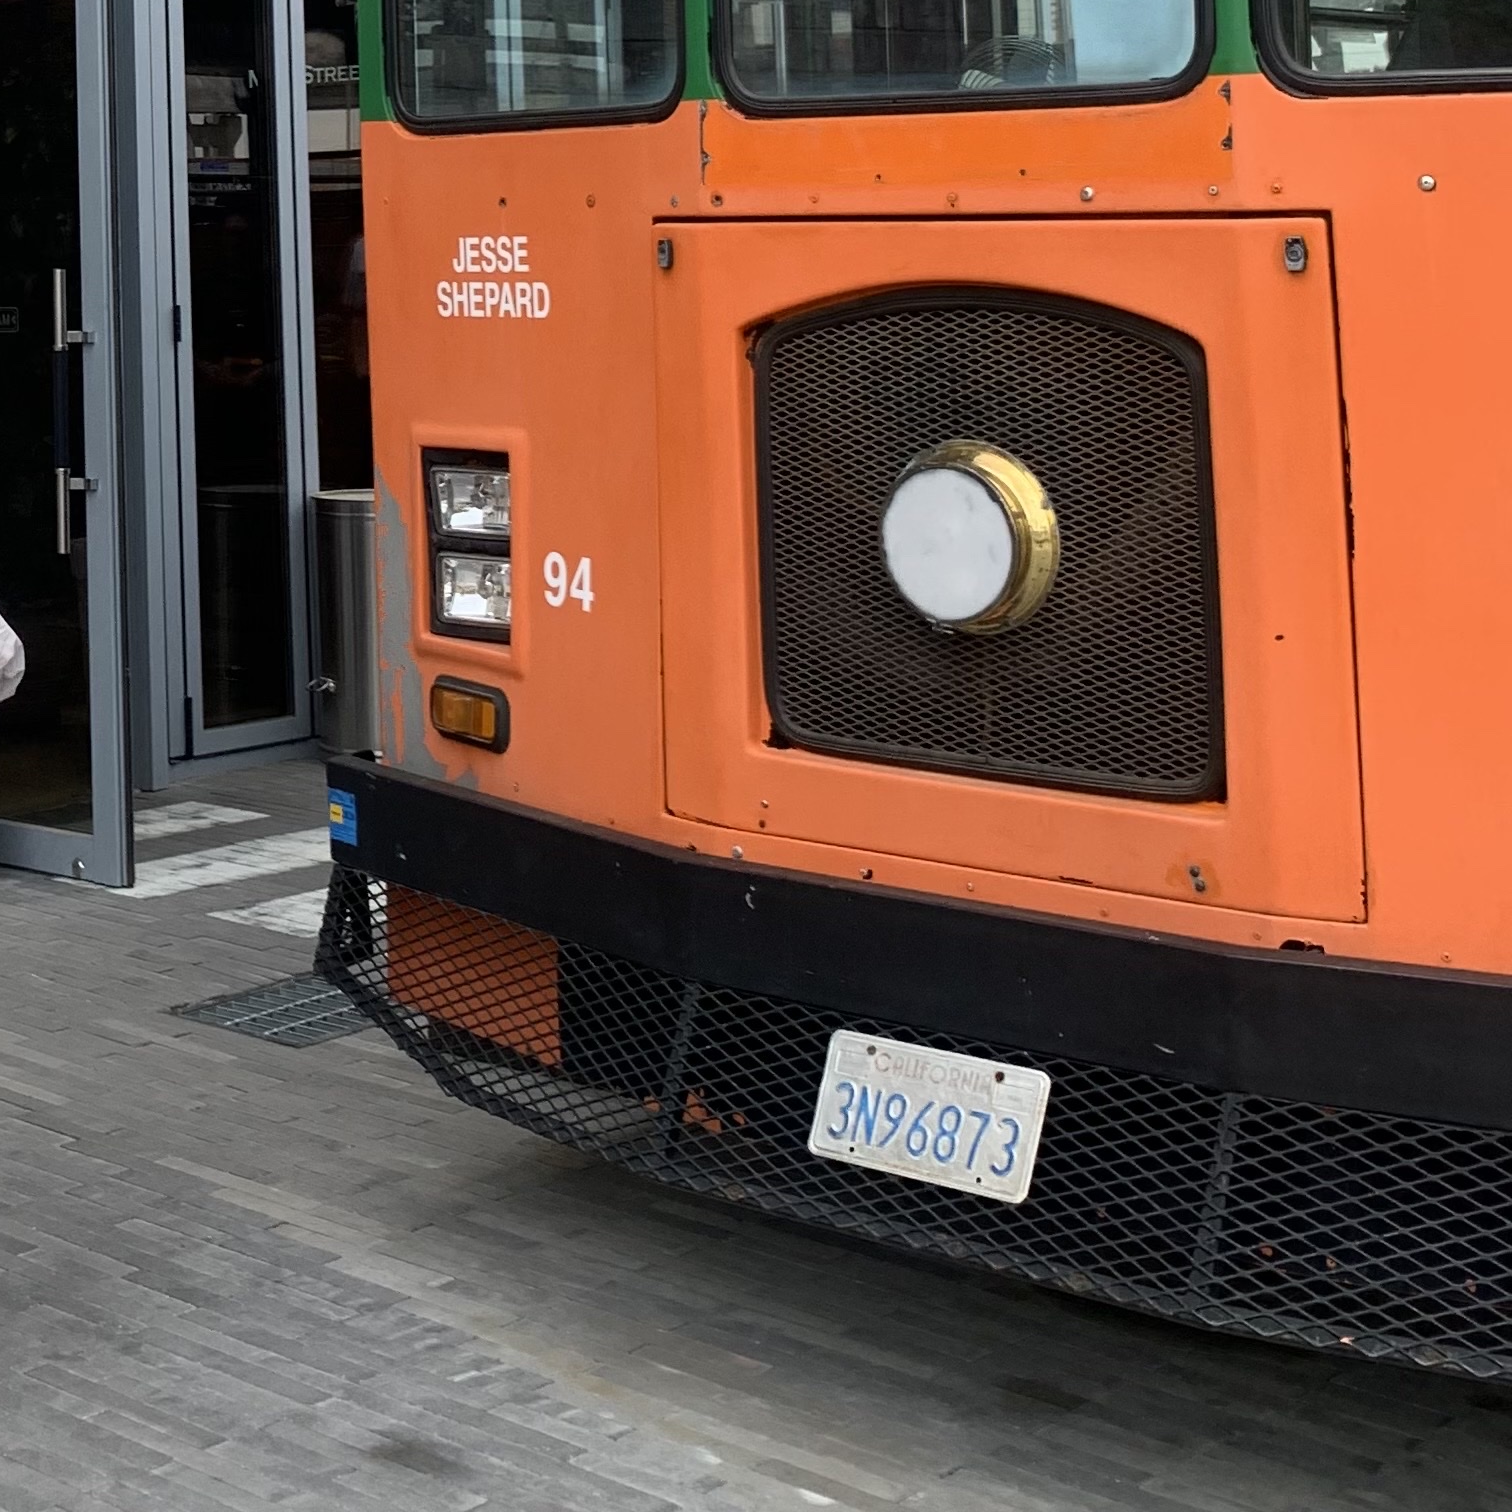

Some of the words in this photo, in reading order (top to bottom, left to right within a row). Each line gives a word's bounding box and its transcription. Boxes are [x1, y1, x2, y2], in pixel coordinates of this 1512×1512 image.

[305, 64, 359, 84] STREE
[452, 235, 530, 273] JESSE
[436, 280, 551, 319] SHEPARD
[543, 551, 595, 613] 94
[874, 1051, 994, 1094] CALIFORNIA
[826, 1081, 1020, 1177] 3N96873
